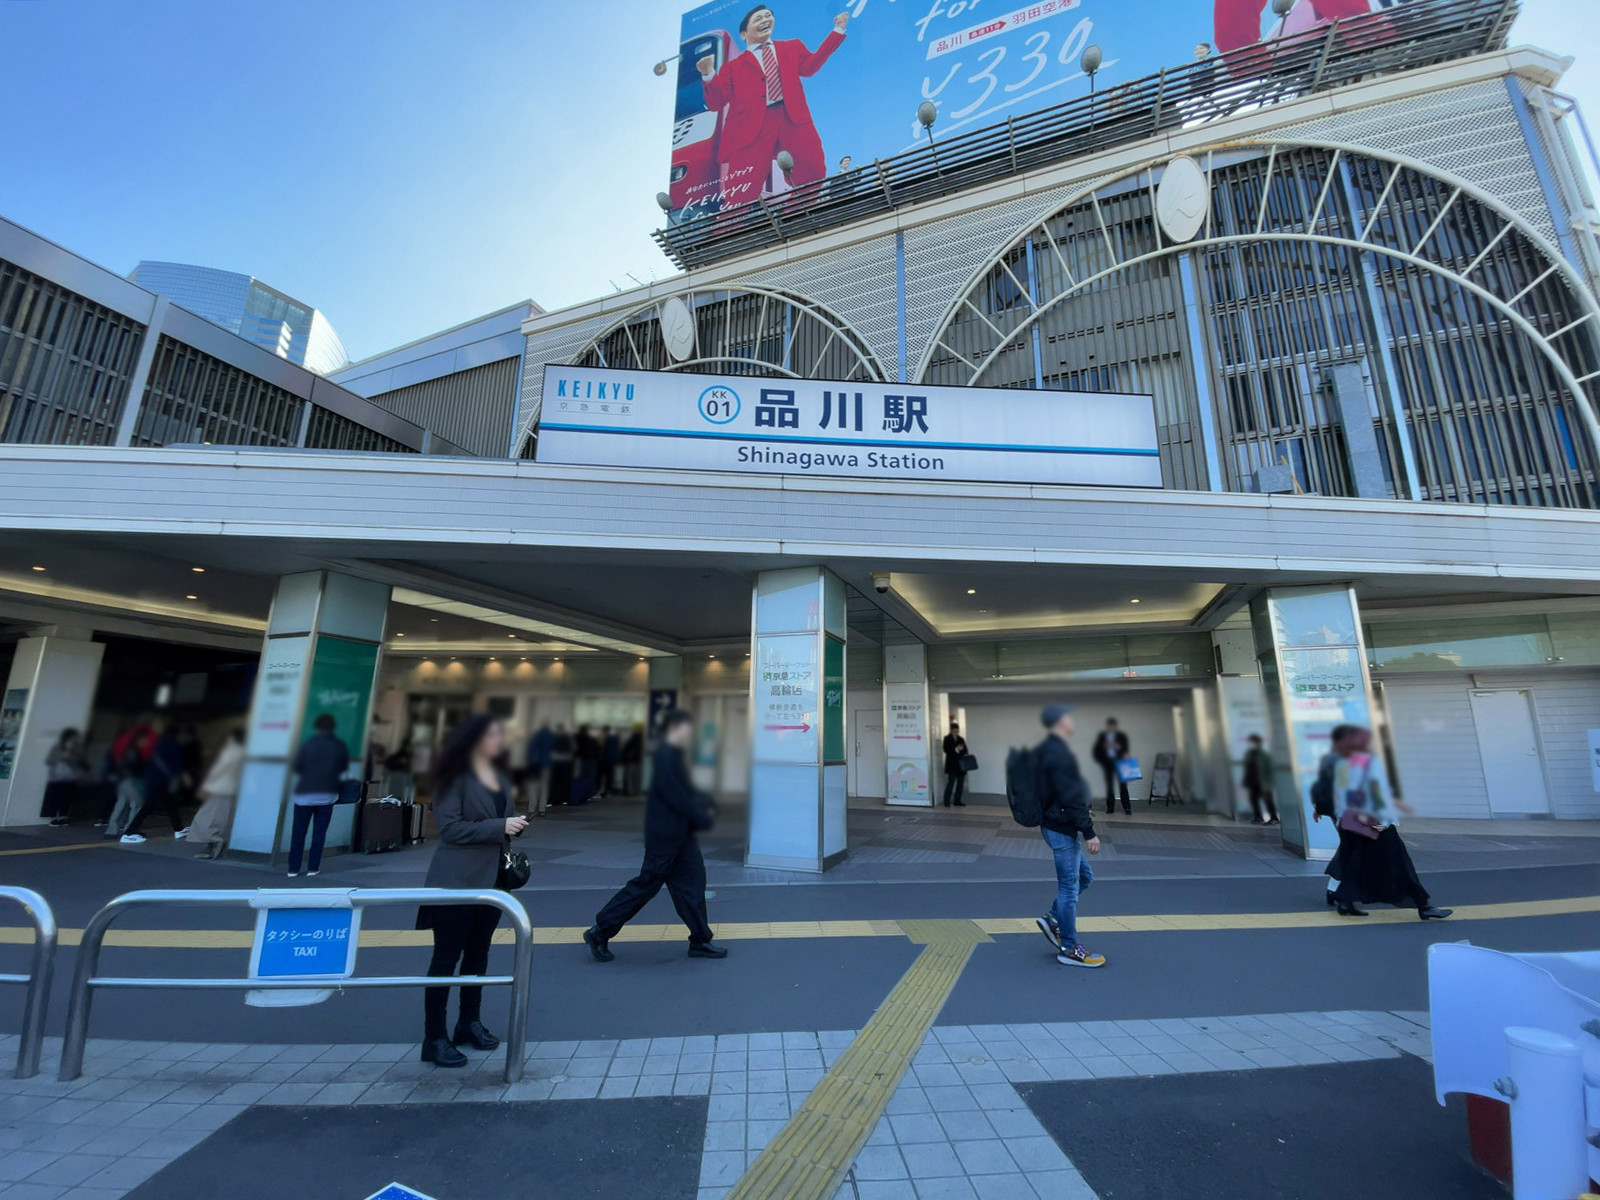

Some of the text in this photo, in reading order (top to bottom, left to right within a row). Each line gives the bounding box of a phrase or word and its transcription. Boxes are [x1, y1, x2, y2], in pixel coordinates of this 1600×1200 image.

[936, 33, 963, 52] 品川
[1012, 0, 1072, 24] 羽田空港
[680, 182, 751, 217] KEIKYU
[557, 379, 635, 401] KEIKYU
[712, 390, 727, 399] KK
[559, 402, 631, 414] 京急電鉄
[706, 400, 731, 417] 01
[755, 388, 929, 434] 品川駅
[737, 446, 945, 470] Shinagawa Station
[772, 671, 812, 681] 京急ストア
[770, 685, 803, 697] 高輪店
[1307, 683, 1356, 692] 京急ストア
[267, 927, 348, 942] タクシーのりば
[293, 946, 318, 957] TAXI
